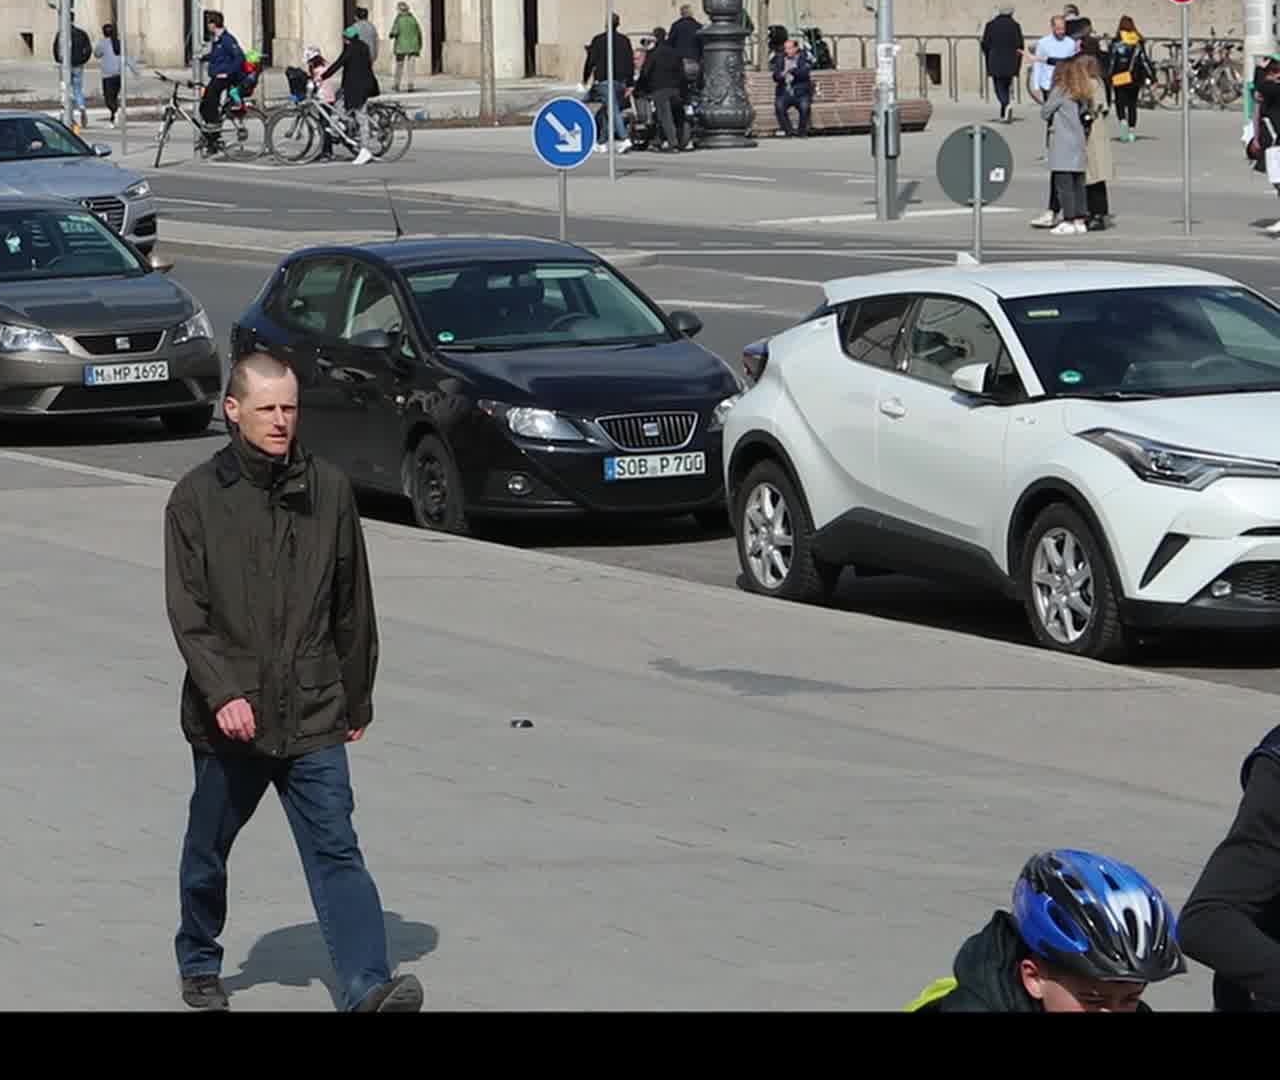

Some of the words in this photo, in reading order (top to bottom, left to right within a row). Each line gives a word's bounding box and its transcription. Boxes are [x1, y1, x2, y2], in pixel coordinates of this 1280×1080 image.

[134, 363, 166, 380] 1692
[616, 458, 648, 476] SOB
[673, 454, 704, 473] 700
